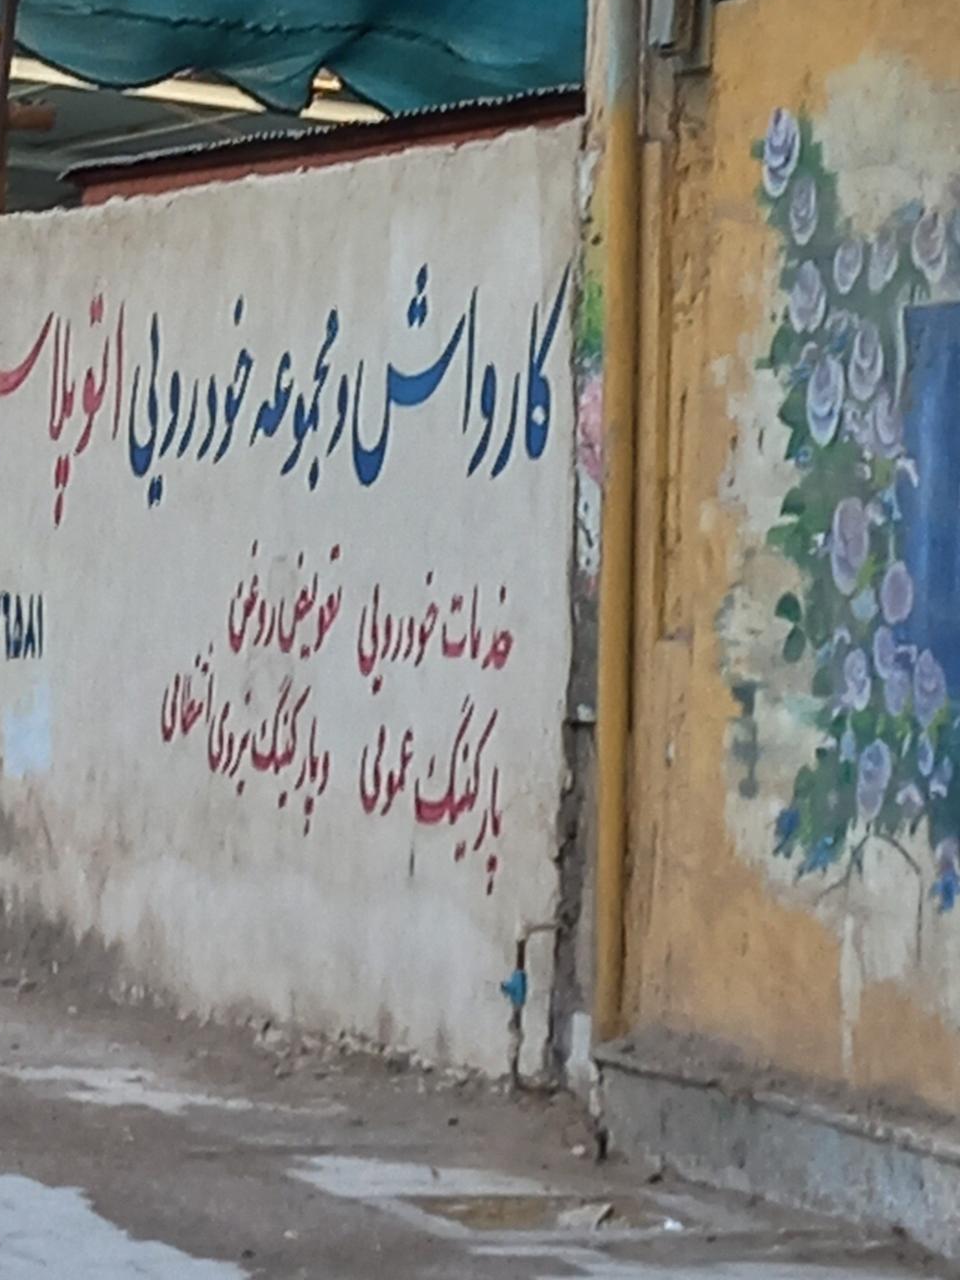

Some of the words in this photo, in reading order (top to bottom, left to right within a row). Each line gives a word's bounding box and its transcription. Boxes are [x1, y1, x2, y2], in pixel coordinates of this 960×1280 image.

[251, 308, 339, 491] مجموعه
[327, 373, 350, 457] و
[351, 263, 570, 488] کارواش
[228, 539, 276, 655] روغن
[277, 542, 343, 660] تعویض
[441, 584, 514, 671] خدمات
[160, 639, 216, 745] انتظامی
[251, 675, 318, 838] پارکینگ
[359, 714, 414, 816] عمومی
[414, 694, 504, 896] پارکینگ
